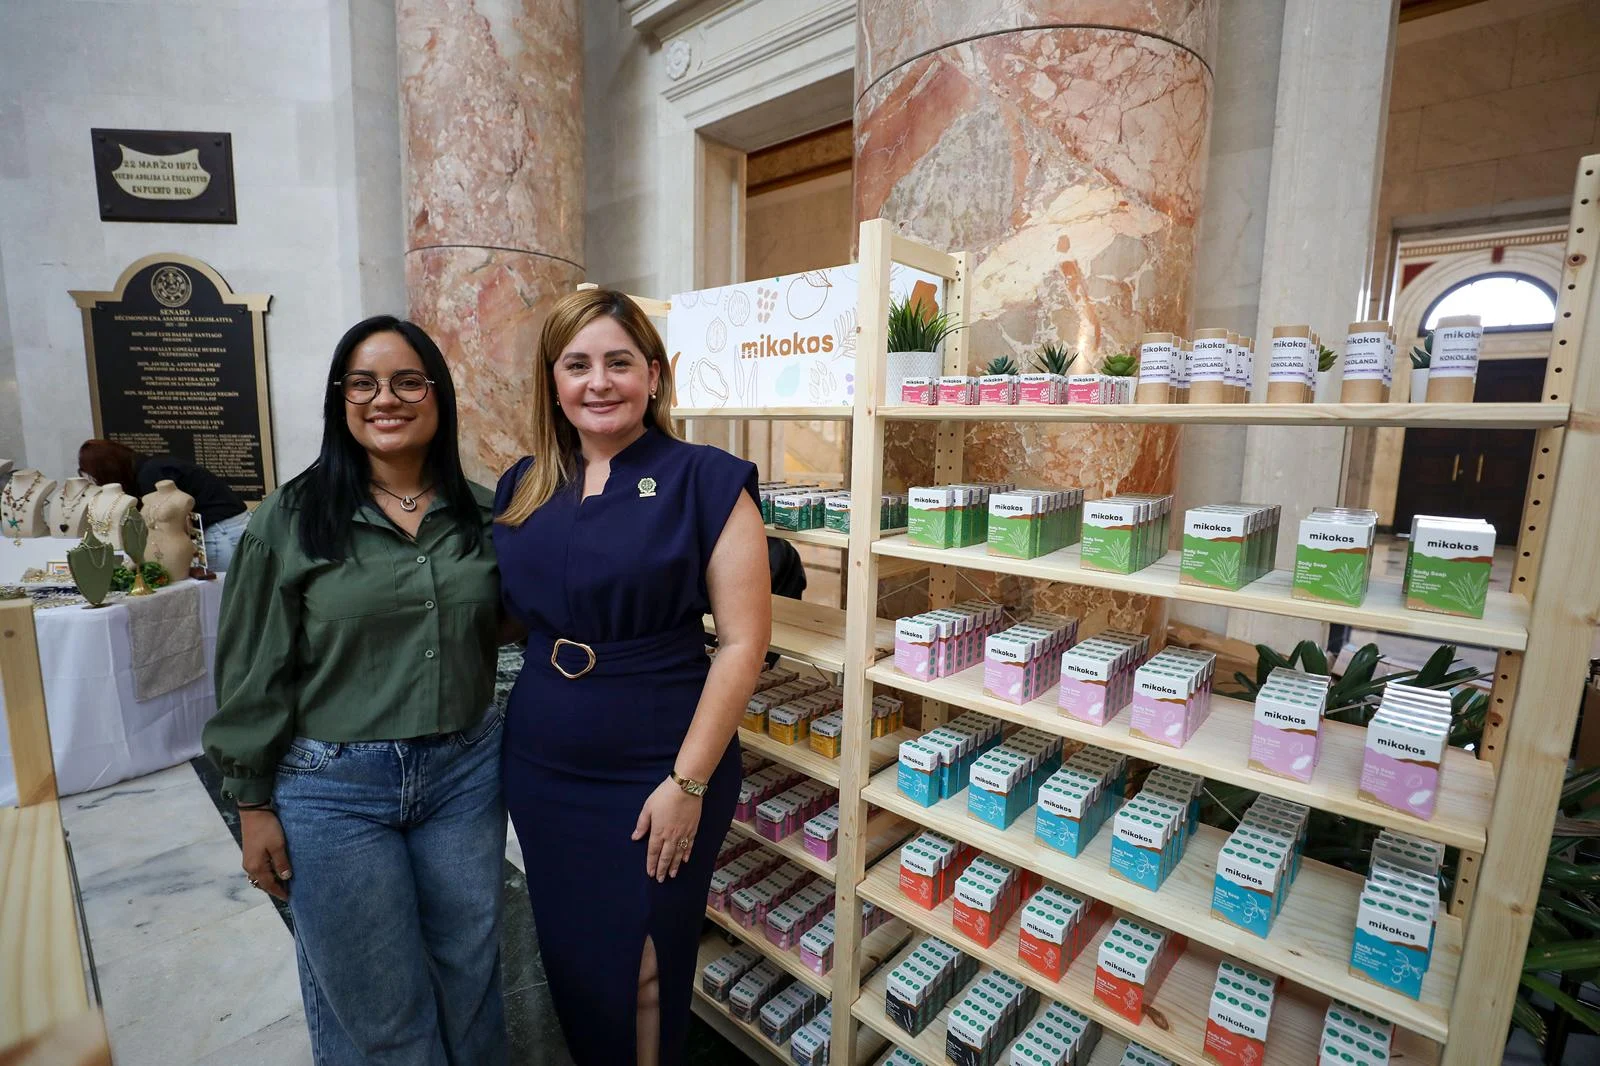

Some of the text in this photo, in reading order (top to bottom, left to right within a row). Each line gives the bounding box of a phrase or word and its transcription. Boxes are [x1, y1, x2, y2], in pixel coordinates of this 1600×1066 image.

[138, 160, 173, 169] MARZO
[741, 332, 834, 359] mikokos
[1091, 512, 1123, 521] mikokos
[1193, 523, 1232, 532] mikokos
[1309, 533, 1354, 543] mikokos
[1427, 540, 1479, 551] mikokos
[900, 630, 922, 639] mikokos
[991, 648, 1017, 659] mikokos
[1068, 665, 1098, 677] mikokos
[1142, 682, 1176, 695] mikokos
[1264, 710, 1306, 725] mikokos
[1377, 737, 1426, 756] mikokos
[904, 754, 924, 767] mikokos
[975, 775, 999, 789] mikokos
[1044, 799, 1072, 813] mikokos
[1121, 828, 1153, 844] mikokos
[905, 859, 927, 872] mikokos
[1225, 866, 1263, 885] mikokos
[960, 891, 983, 907] mikokos
[1026, 922, 1054, 939] mikokos
[1368, 919, 1416, 940] mikokos
[1105, 959, 1136, 978] mikokos
[1218, 1012, 1256, 1034] mikokos
[952, 1025, 974, 1043] mikokos
